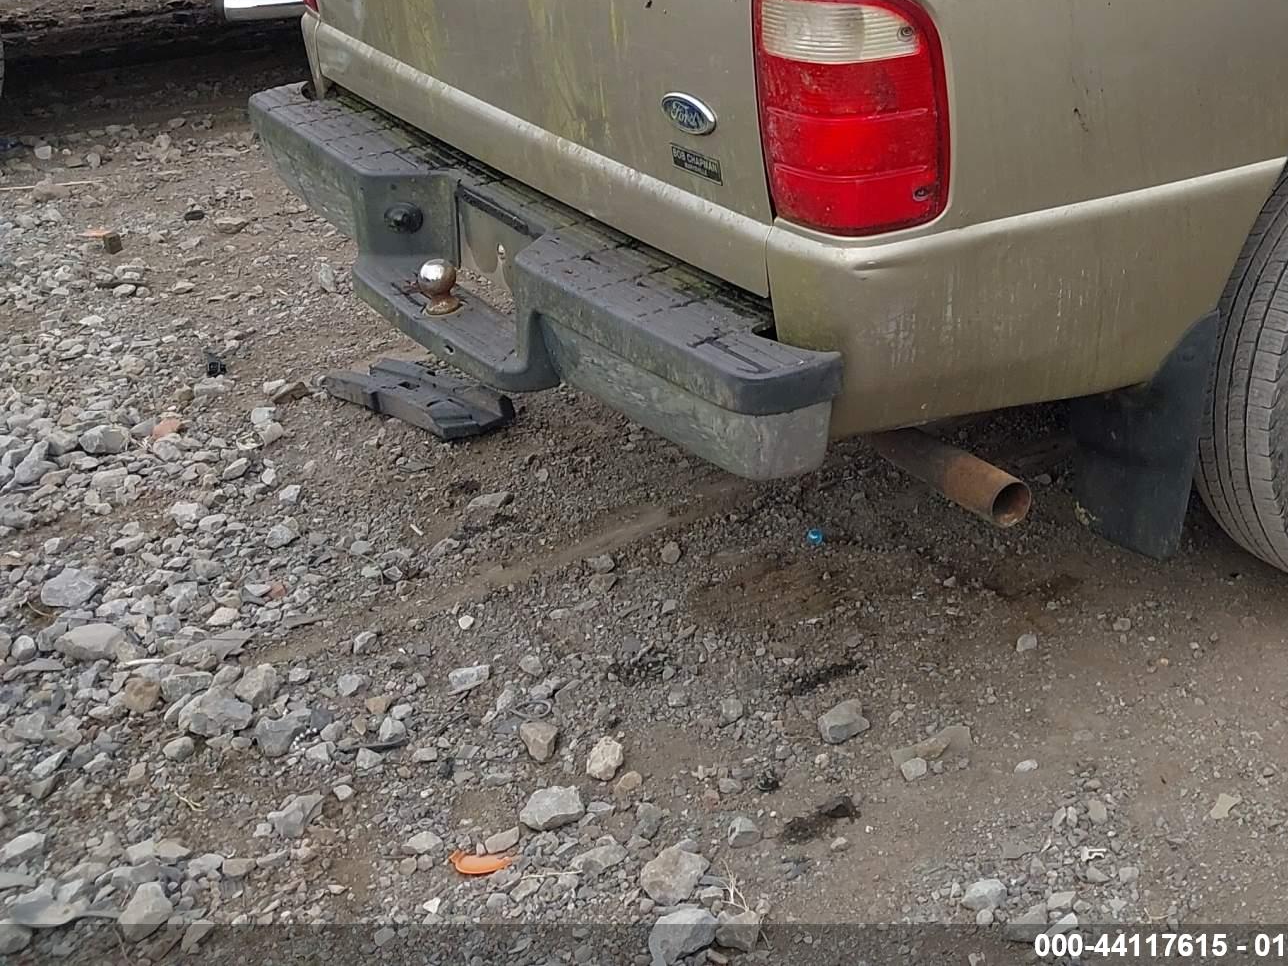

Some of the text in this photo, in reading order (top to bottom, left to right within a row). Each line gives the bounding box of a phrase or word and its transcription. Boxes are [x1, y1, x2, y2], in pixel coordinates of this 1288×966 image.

[670, 101, 701, 130] Ford
[672, 147, 686, 161] BOB
[687, 152, 718, 172] CHAPMAN
